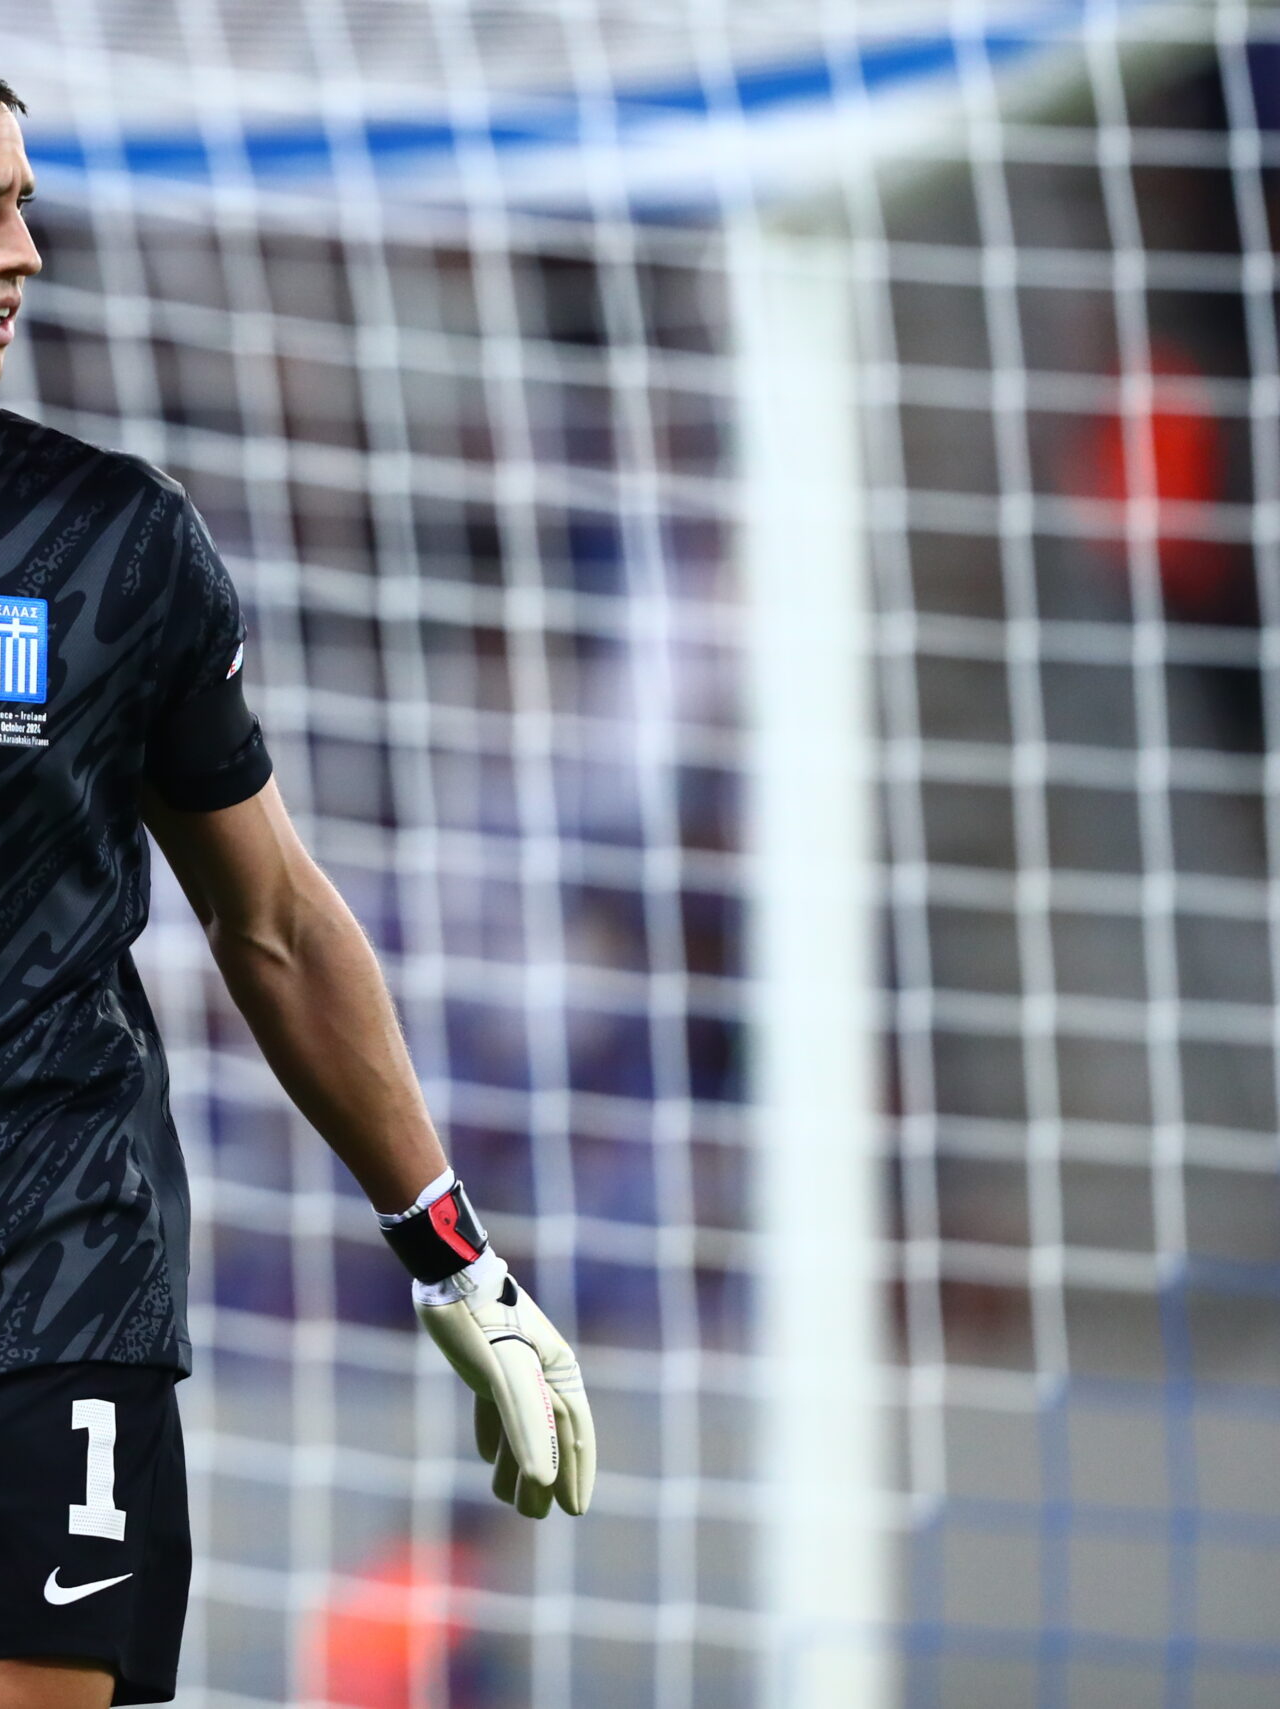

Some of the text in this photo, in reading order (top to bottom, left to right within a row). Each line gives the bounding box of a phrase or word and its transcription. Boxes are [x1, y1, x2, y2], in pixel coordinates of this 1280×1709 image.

[20, 710, 47, 722] Ireland
[0, 721, 26, 733] October
[26, 722, 41, 734] 2024
[68, 1398, 126, 1542] 1
